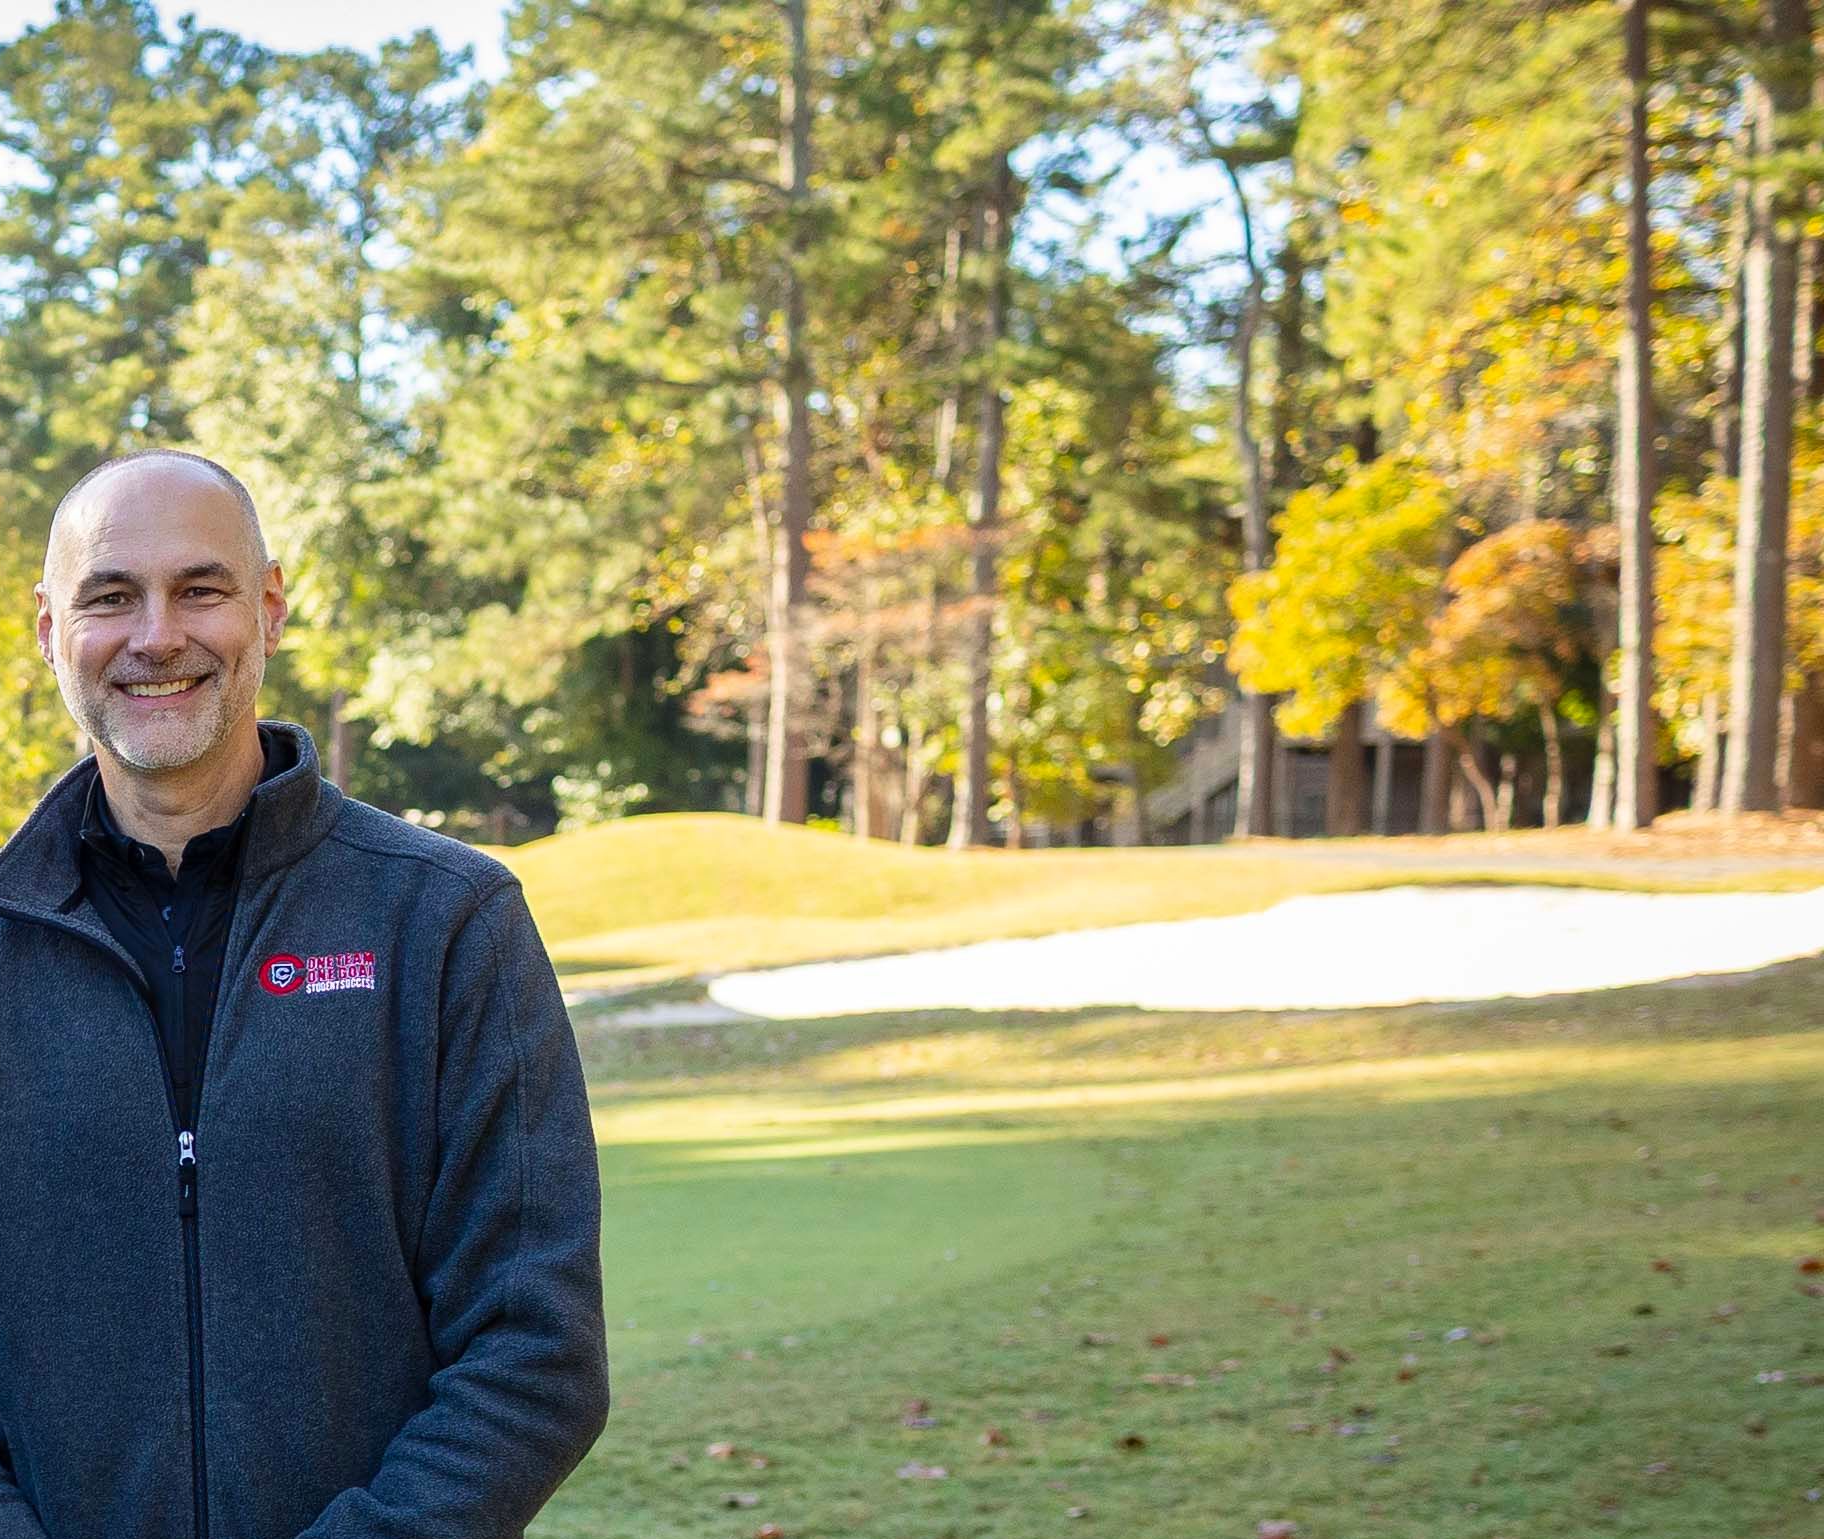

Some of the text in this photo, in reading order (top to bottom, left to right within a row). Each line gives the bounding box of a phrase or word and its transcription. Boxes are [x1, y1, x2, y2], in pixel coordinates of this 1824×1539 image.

[307, 950, 374, 970] ONE TEAM
[307, 968, 334, 983] ONE
[305, 981, 340, 994] STUDENT
